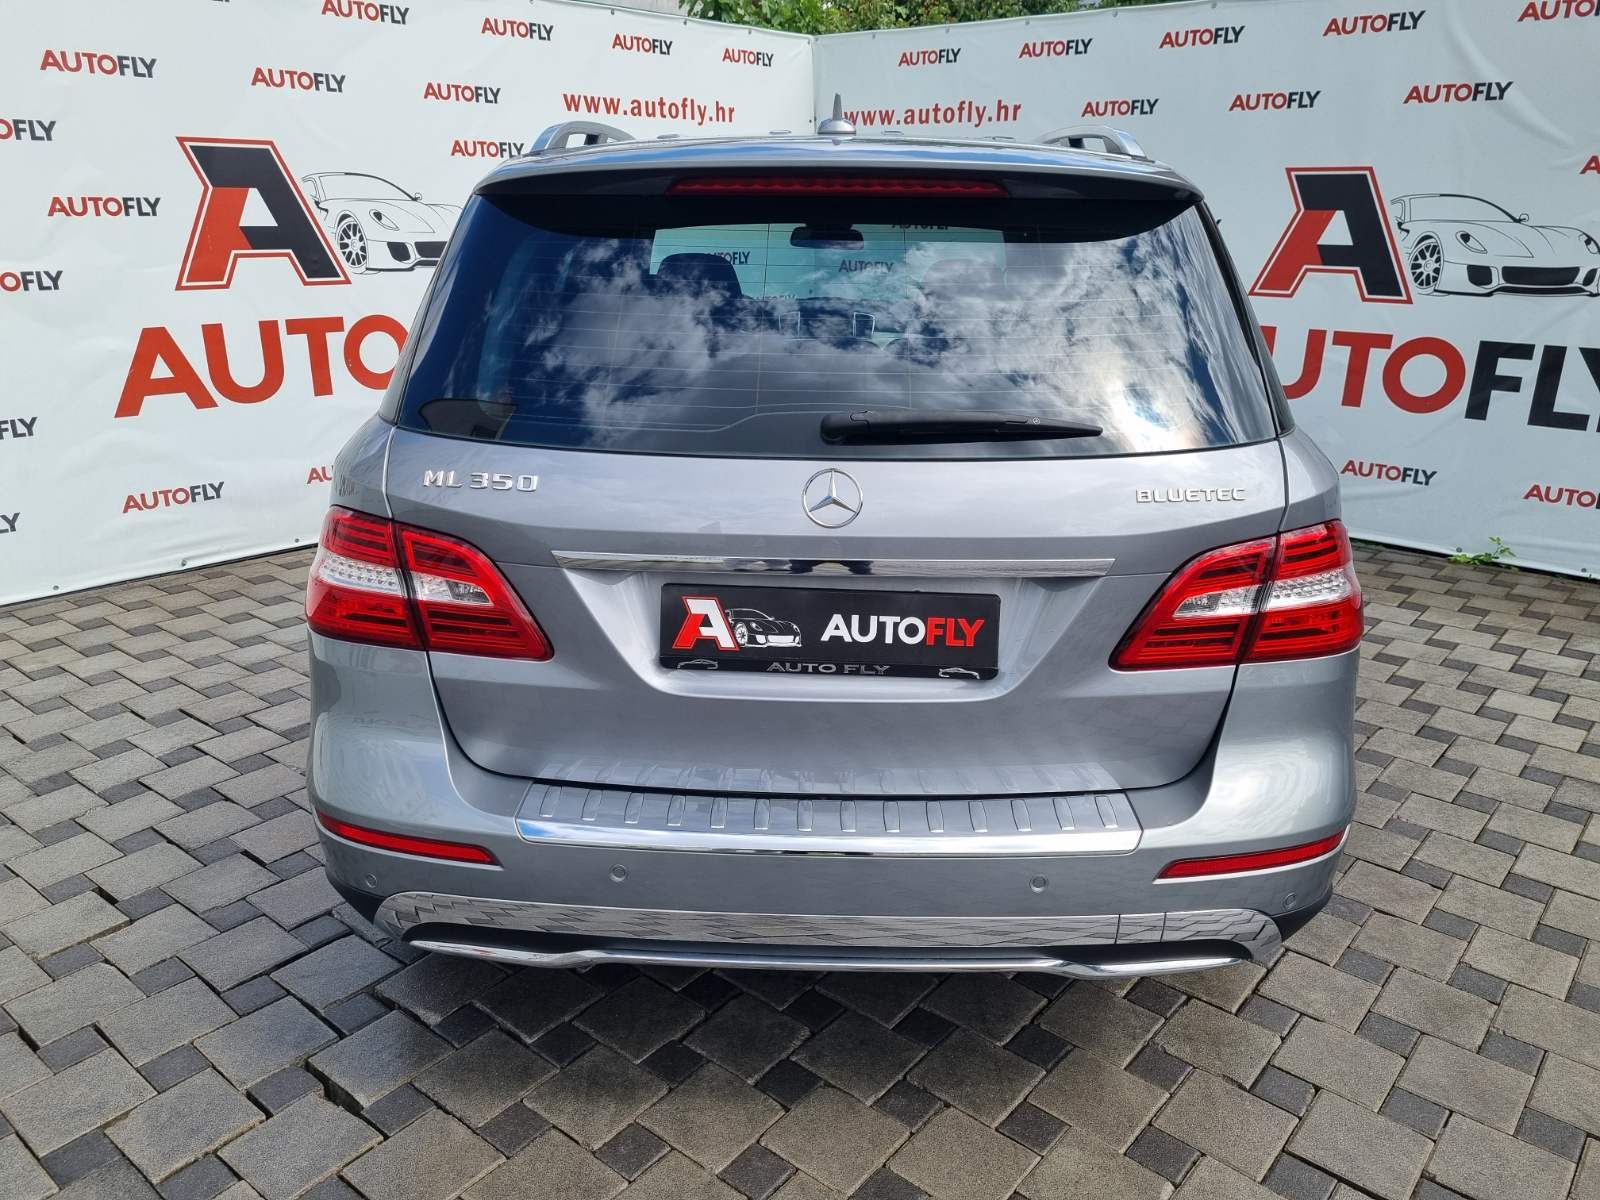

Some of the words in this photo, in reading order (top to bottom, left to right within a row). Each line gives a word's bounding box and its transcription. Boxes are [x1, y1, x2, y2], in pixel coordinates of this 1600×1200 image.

[322, 0, 409, 24] AUTOFLY
[1323, 10, 1426, 36] AUTOFLY
[481, 18, 553, 41] AUTOFLY
[1159, 26, 1245, 48] AUTOFLY
[612, 34, 672, 55] AUTOFLY
[1019, 38, 1092, 58] AUTOFLY
[40, 50, 156, 78] AUTOFLY
[723, 48, 773, 67] AUTOFLY
[899, 48, 961, 66] AUTOFLY
[251, 67, 345, 92] AUTOFLY
[424, 82, 501, 104] AUTOFLY
[1229, 91, 1321, 111] AUTOFLY
[1403, 82, 1513, 104] AUTOFLY
[563, 93, 735, 125] www.autofly.hr
[1082, 99, 1159, 117] AUTOFLY
[451, 140, 524, 158] AUTOFLY
[48, 197, 160, 216] AUTOFLY
[1259, 325, 1600, 433] UTOFL
[423, 470, 462, 487] ML
[470, 473, 539, 492] 350
[1341, 460, 1437, 486] AUTOFLY
[123, 482, 224, 513] AUTOFLY
[1136, 487, 1247, 503] BLUETEC
[821, 614, 984, 647] AUTOFLY
[766, 662, 837, 674] AUTO
[843, 664, 892, 676] FLY
